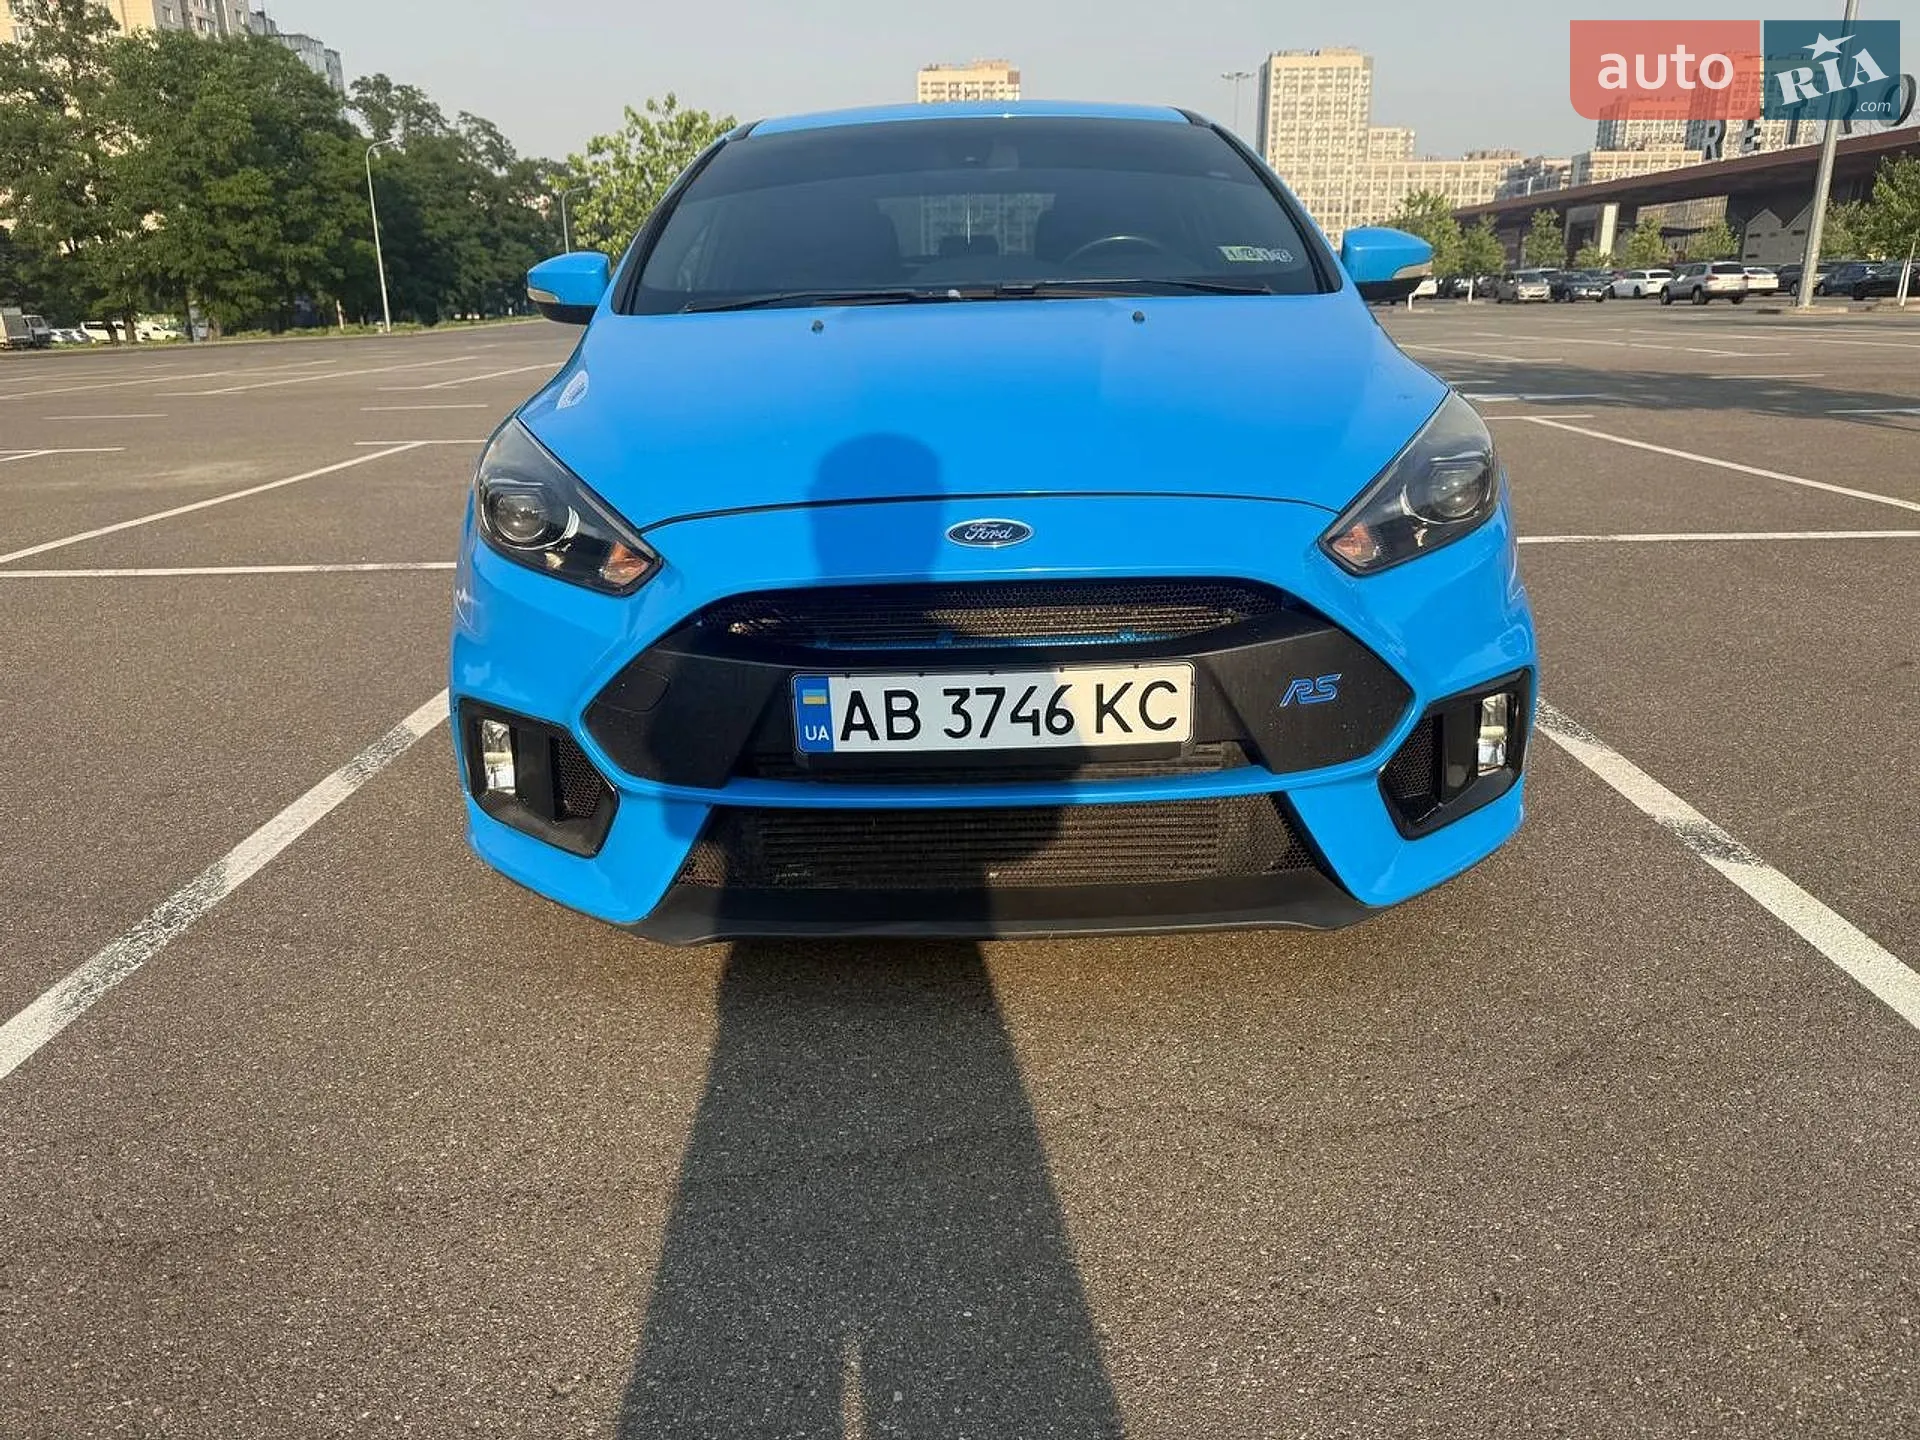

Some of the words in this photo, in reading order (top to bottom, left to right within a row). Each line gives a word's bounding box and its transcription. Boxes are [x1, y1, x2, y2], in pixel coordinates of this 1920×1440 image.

[964, 523, 1014, 541] Ford
[1279, 673, 1342, 708] RS
[840, 689, 921, 741] AB
[943, 684, 1076, 739] 3746
[1095, 680, 1178, 734] KC
[805, 725, 830, 741] UA
